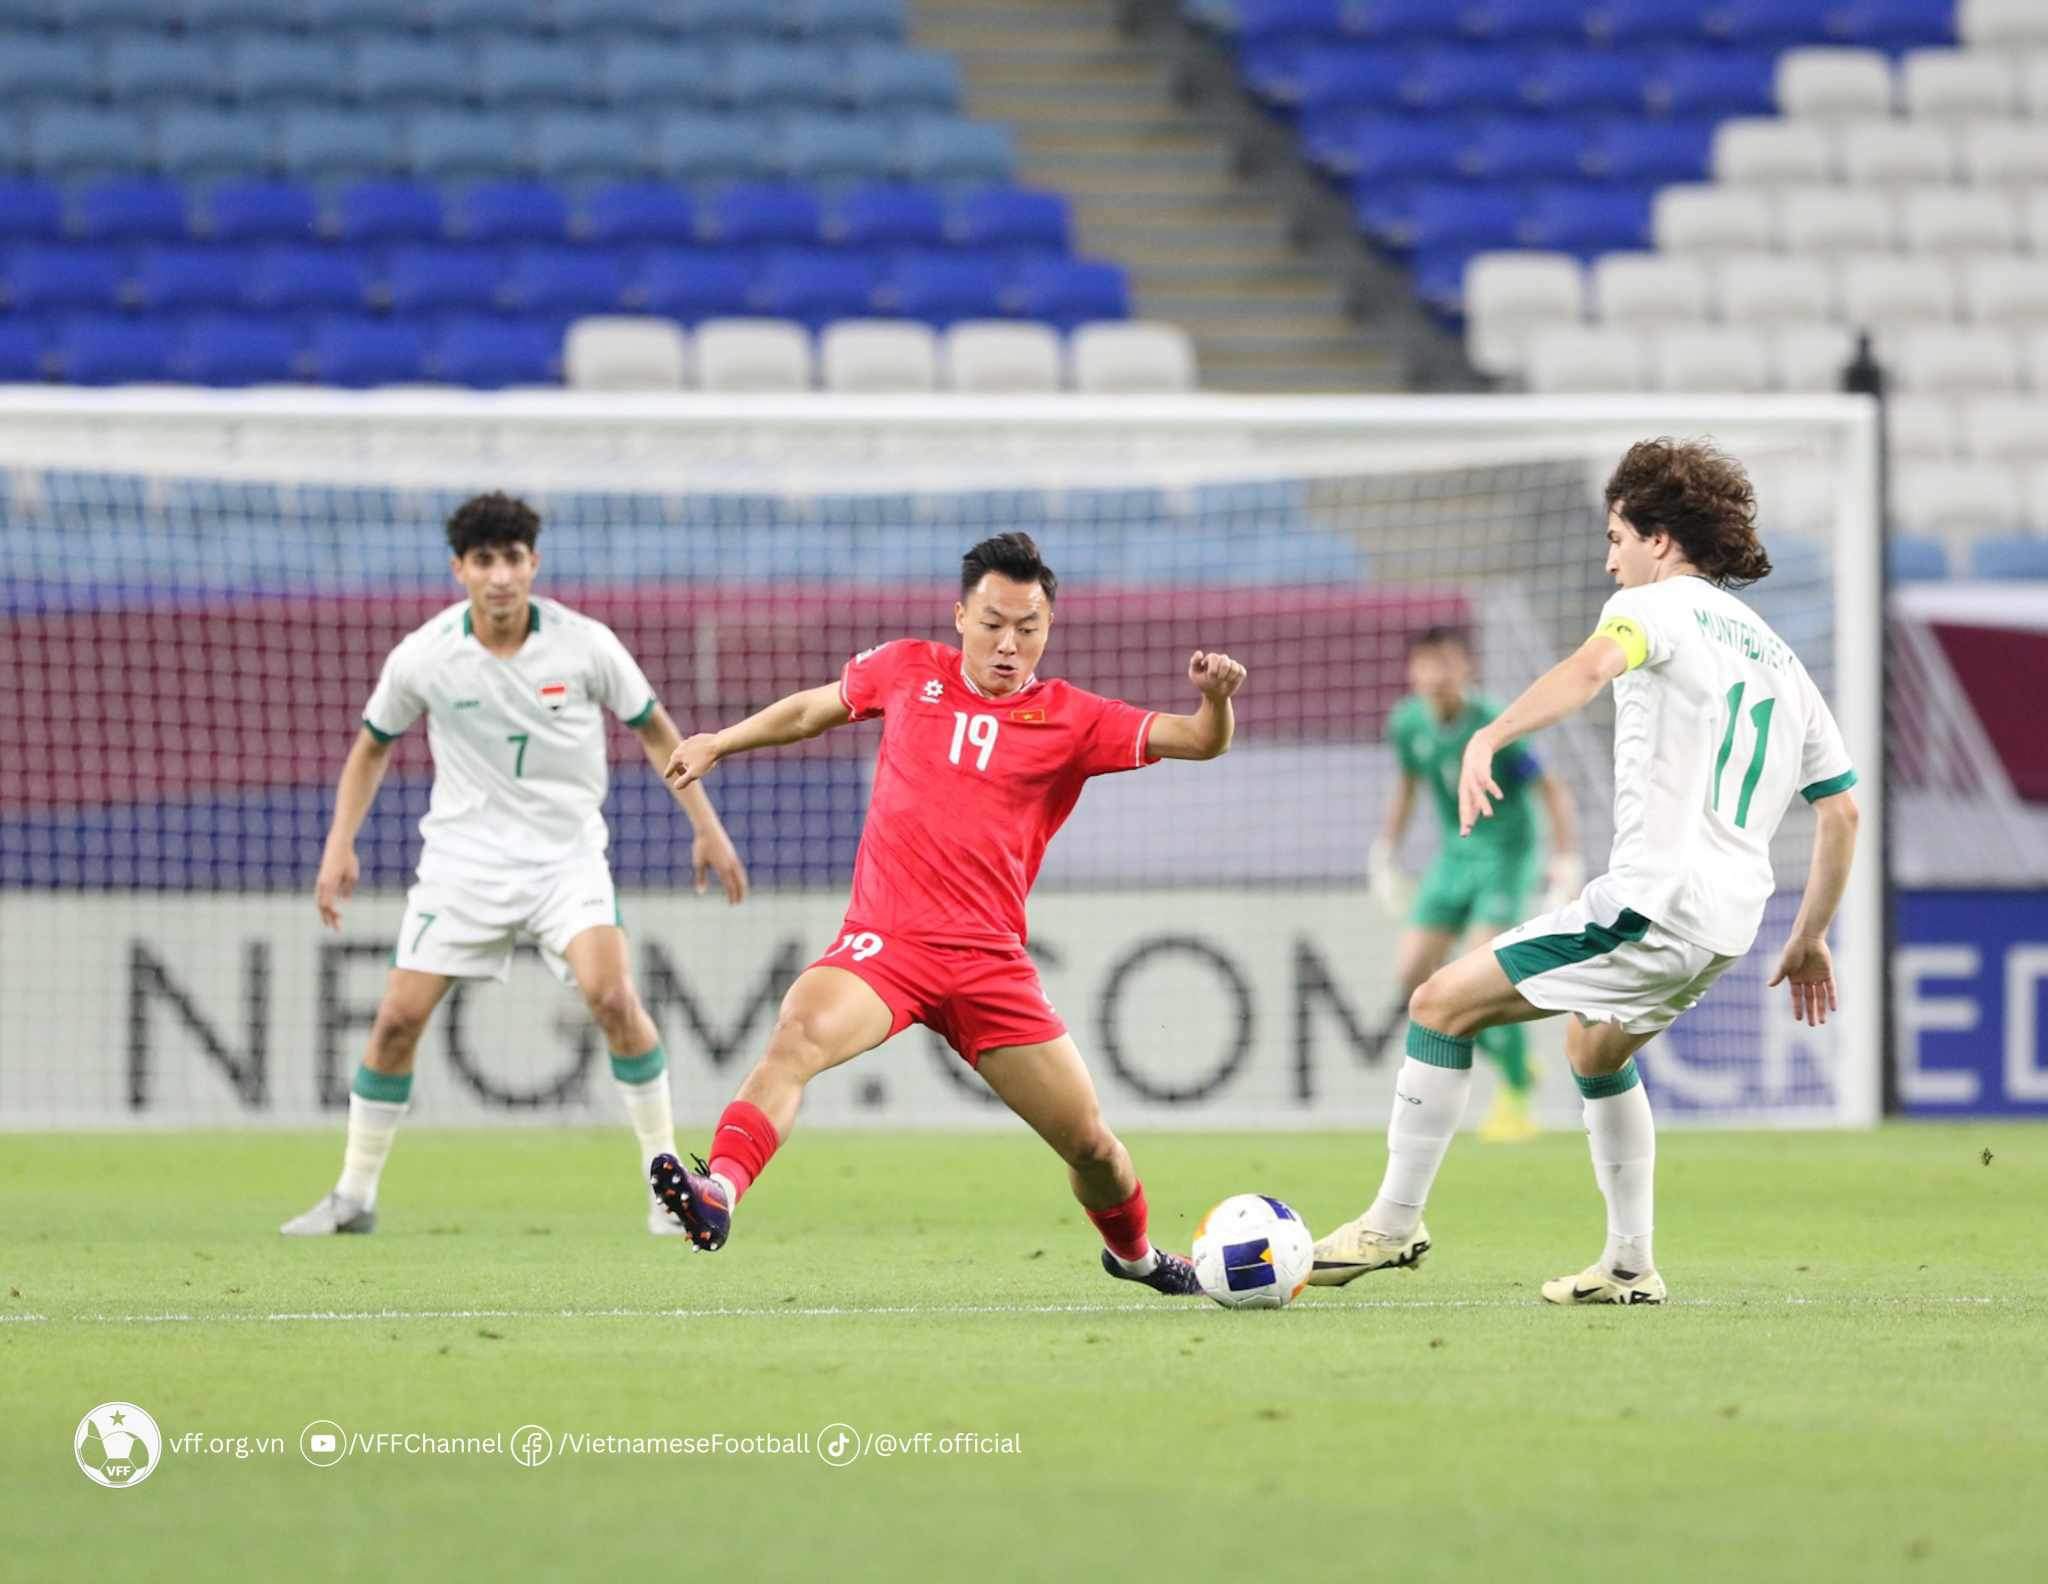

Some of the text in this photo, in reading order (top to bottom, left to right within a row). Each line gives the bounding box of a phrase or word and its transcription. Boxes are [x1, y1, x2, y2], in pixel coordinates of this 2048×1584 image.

[507, 733, 529, 778] 7
[948, 710, 1000, 772] 19
[1712, 680, 1776, 830] 11
[411, 912, 436, 954] 7
